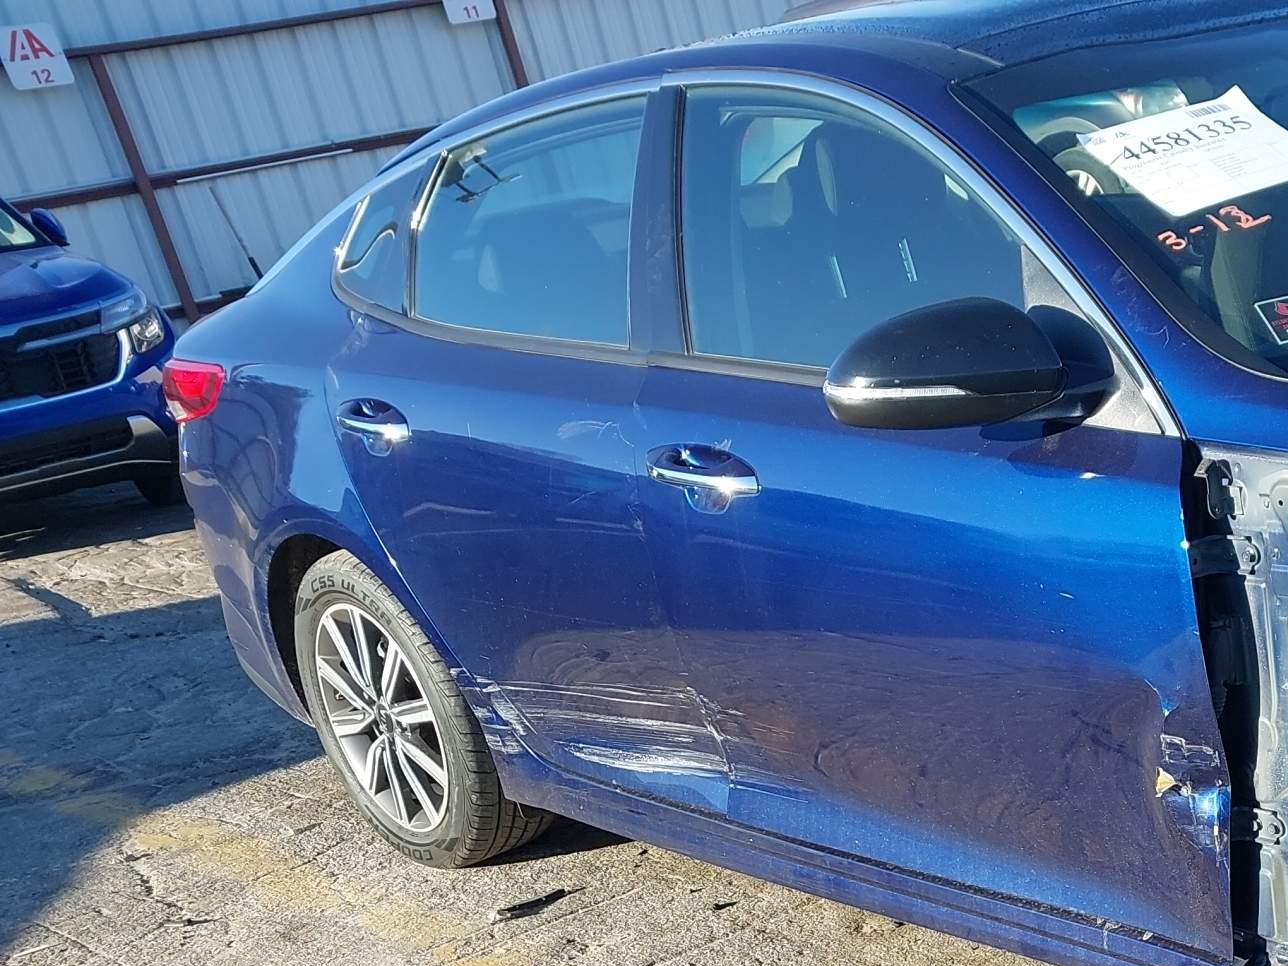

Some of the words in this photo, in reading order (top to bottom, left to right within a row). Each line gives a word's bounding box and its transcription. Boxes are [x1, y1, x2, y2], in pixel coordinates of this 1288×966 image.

[463, 5, 480, 19] 11
[32, 68, 55, 84] 12
[1122, 115, 1252, 161] 44581335
[341, 578, 392, 626] ULTRA
